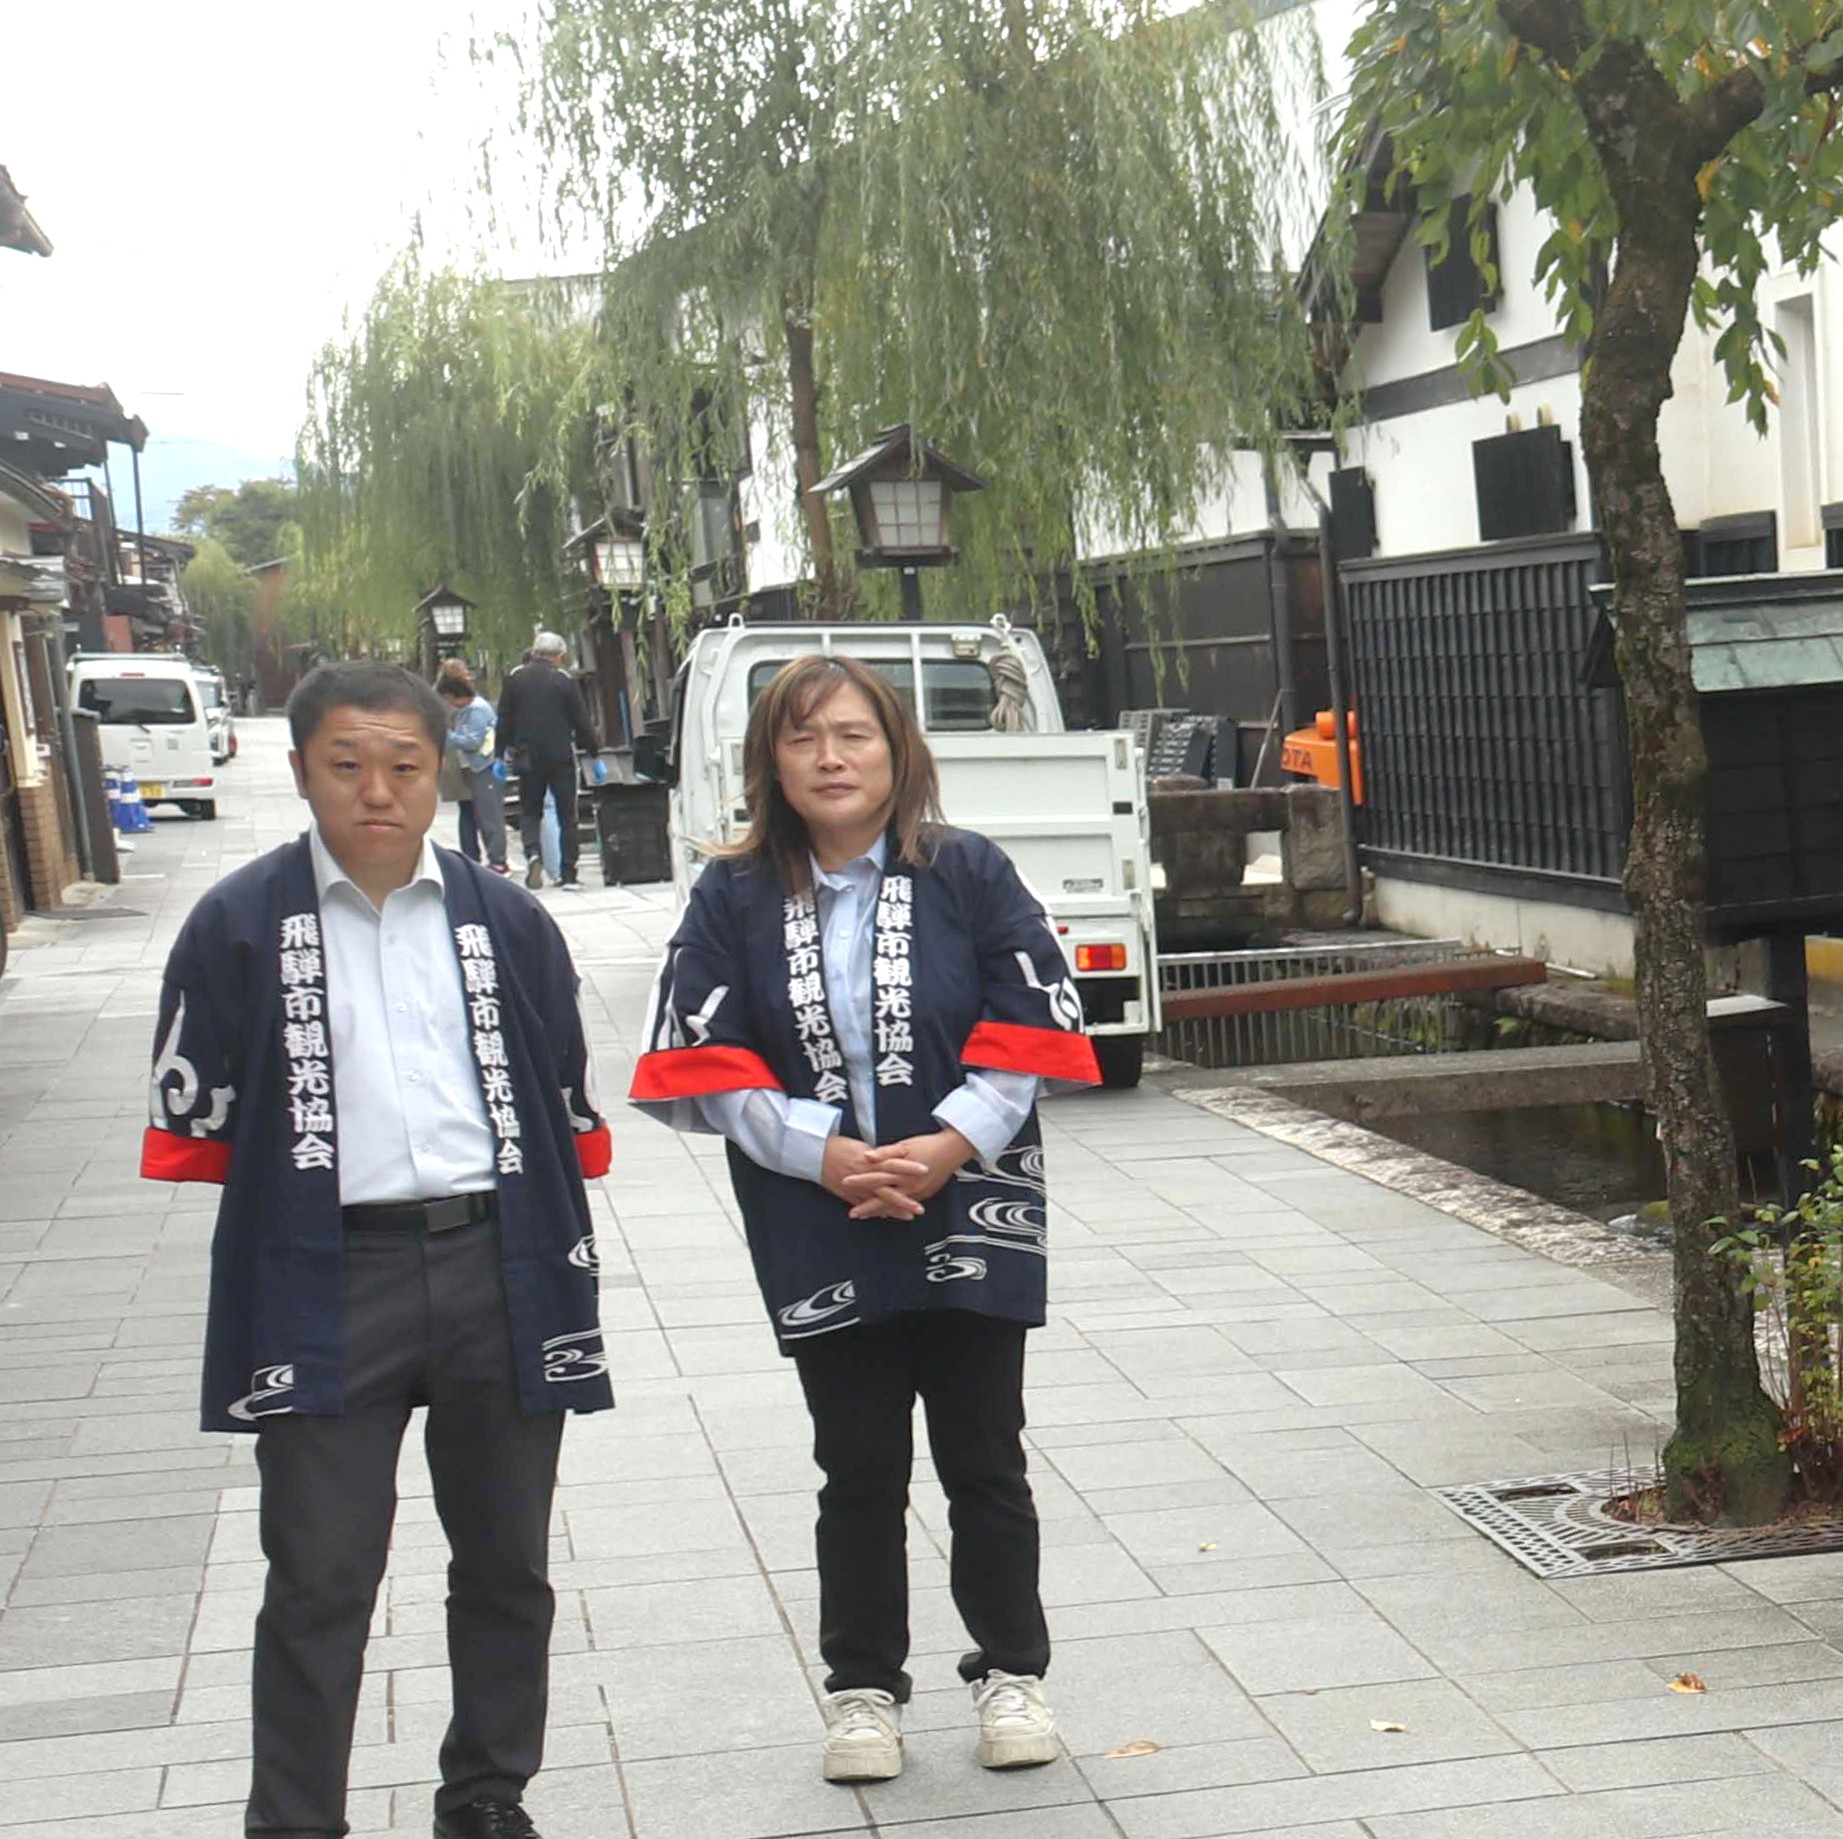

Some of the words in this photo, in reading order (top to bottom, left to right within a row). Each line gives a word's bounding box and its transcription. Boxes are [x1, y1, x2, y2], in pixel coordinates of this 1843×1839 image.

[279, 913, 335, 1171] 飛騨市観光協会
[454, 924, 523, 1175] 飛騨市観光協会
[783, 888, 849, 1103] 飛騨市観光協会
[873, 875, 914, 1087] 飛騨市観光協会
